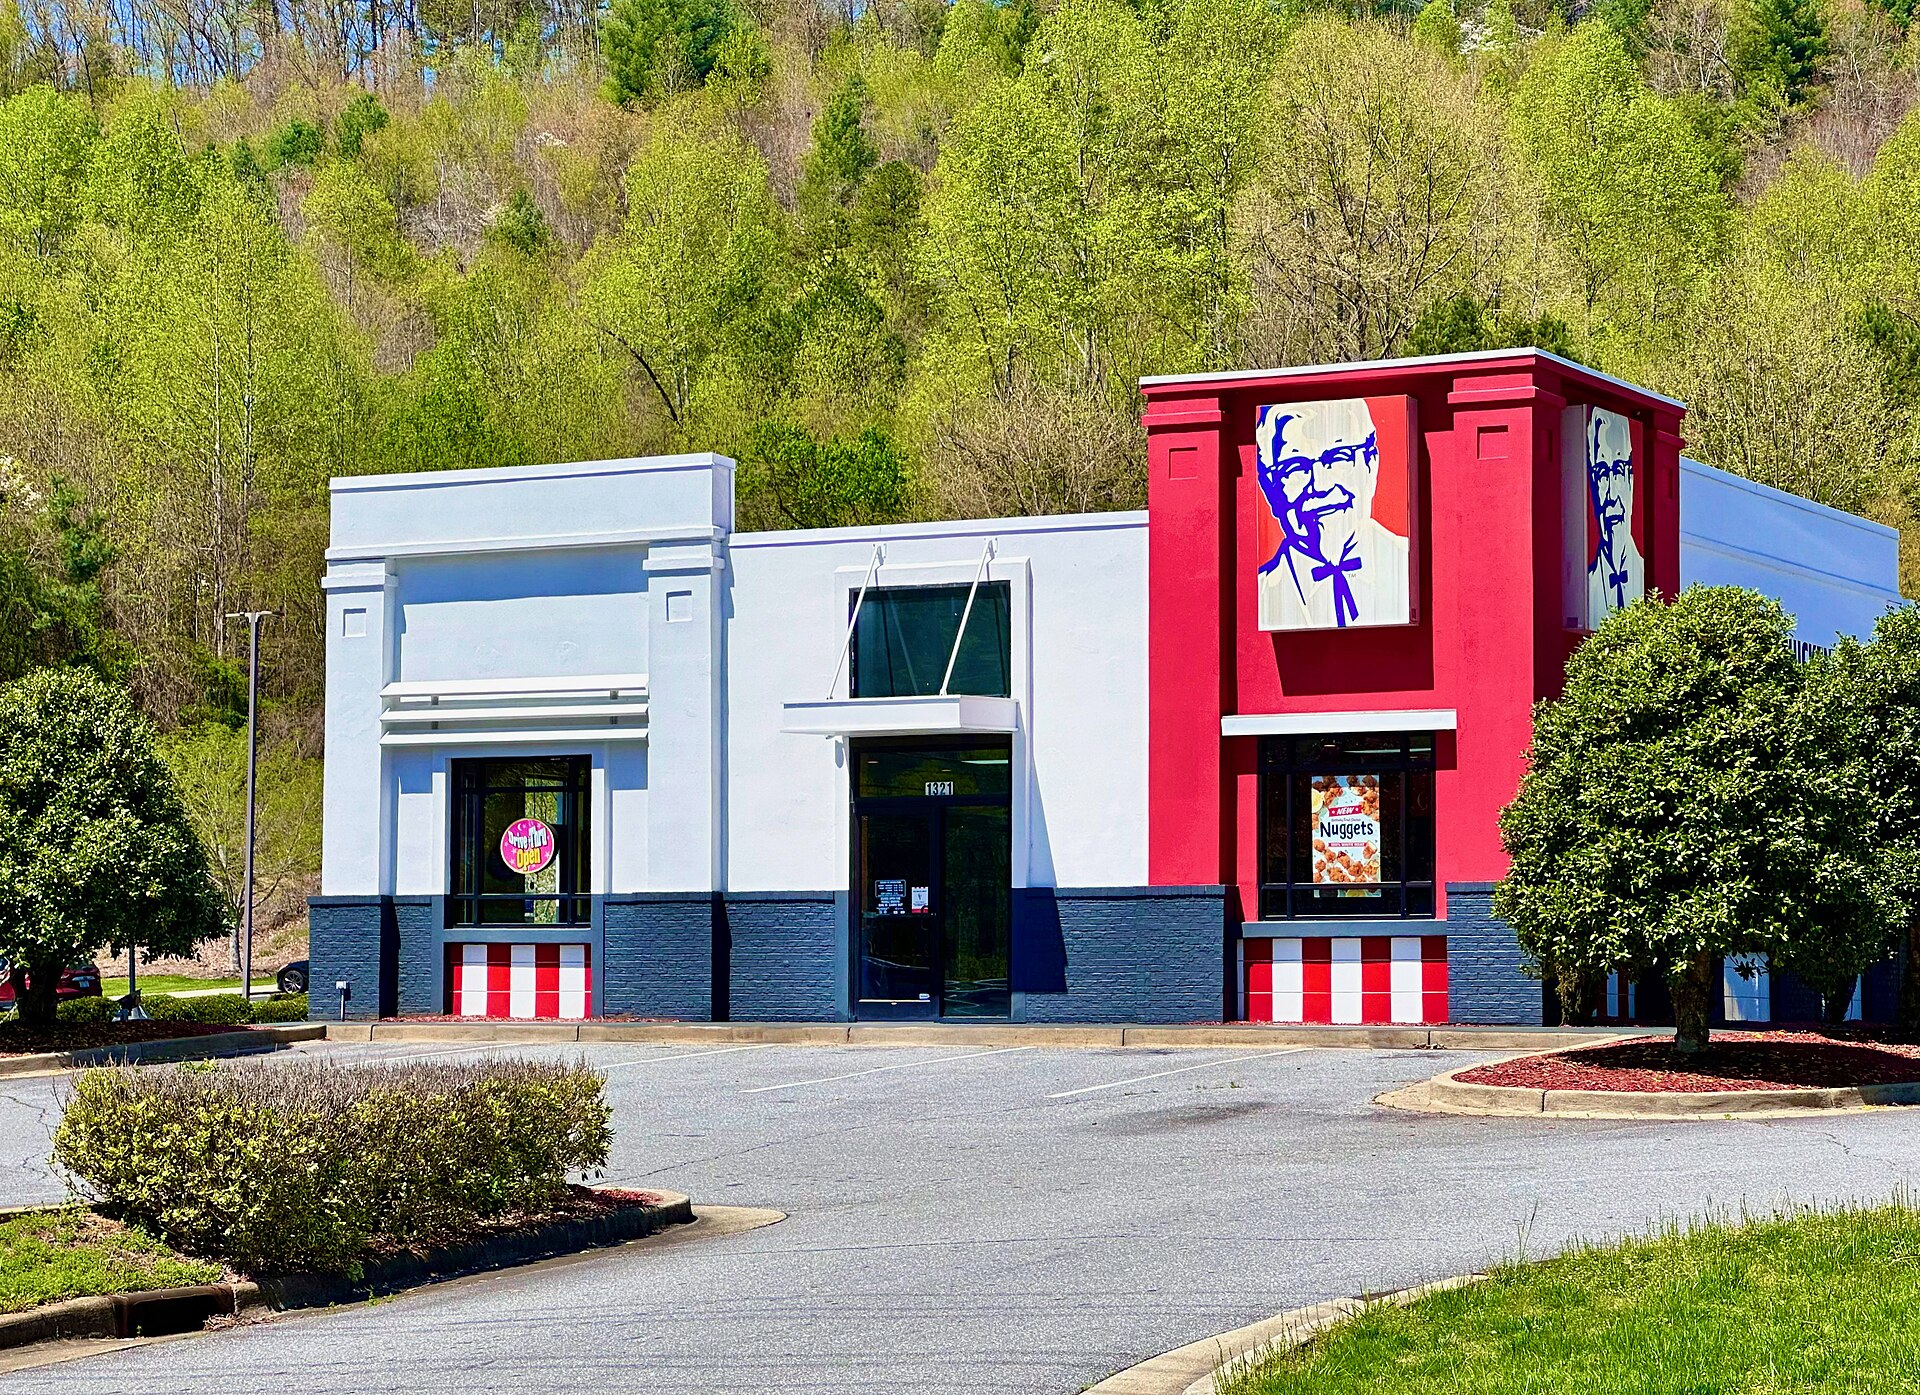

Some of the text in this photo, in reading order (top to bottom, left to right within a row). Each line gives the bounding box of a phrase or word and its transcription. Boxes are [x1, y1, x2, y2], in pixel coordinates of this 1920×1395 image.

[926, 782, 952, 796] 1321
[1336, 805, 1355, 816] NEW
[1320, 821, 1374, 840] Nuggets
[516, 848, 541, 872] Open
